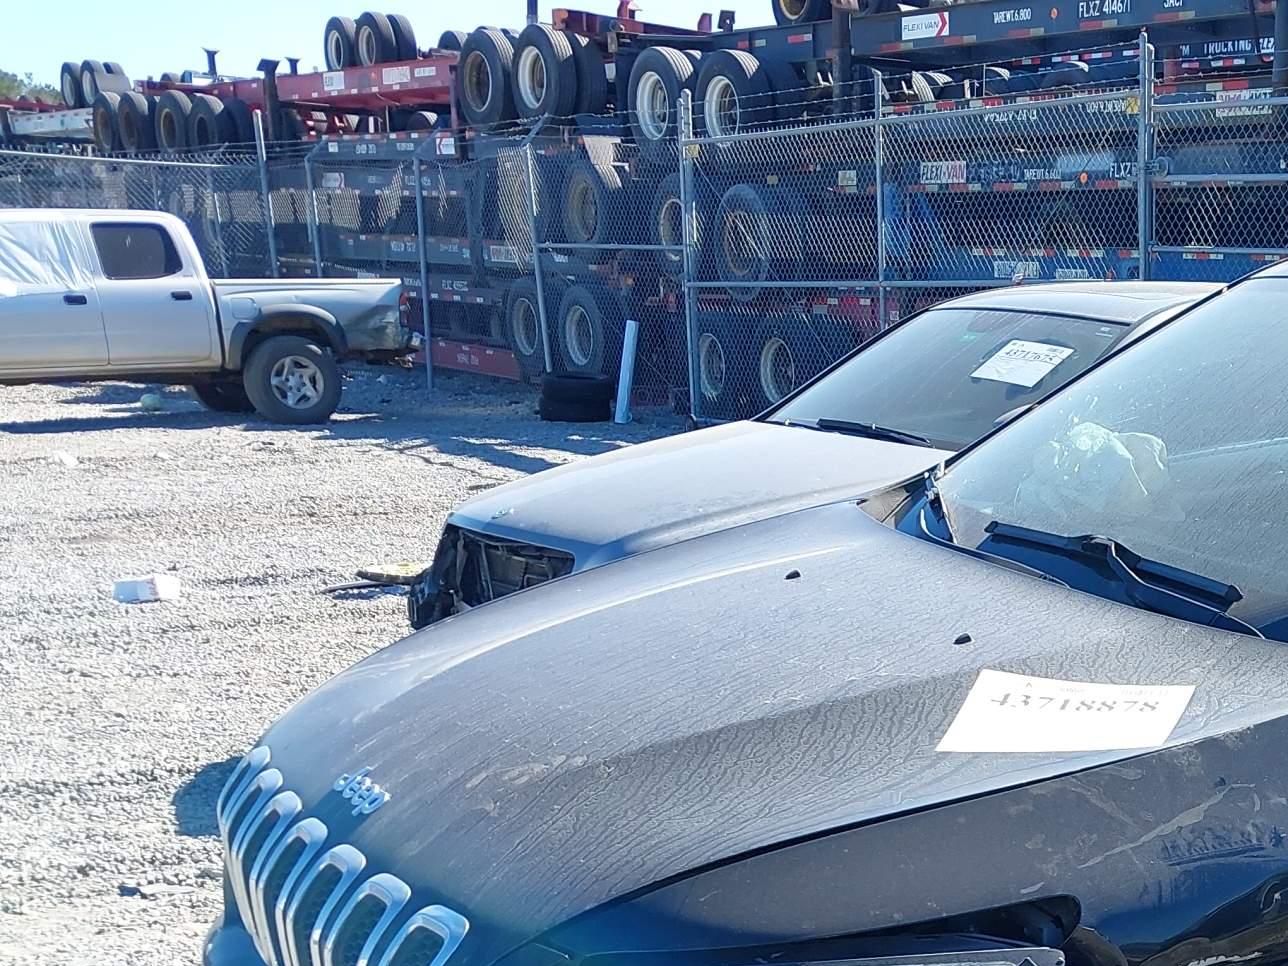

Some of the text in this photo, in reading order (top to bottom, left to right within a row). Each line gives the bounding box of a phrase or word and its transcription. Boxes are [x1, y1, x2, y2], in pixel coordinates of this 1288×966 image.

[1079, 1, 1100, 18] FLXZ
[1109, 162, 1131, 178] FLXZ
[991, 693, 1160, 712] 43718878
[333, 766, 390, 816] Jeep
